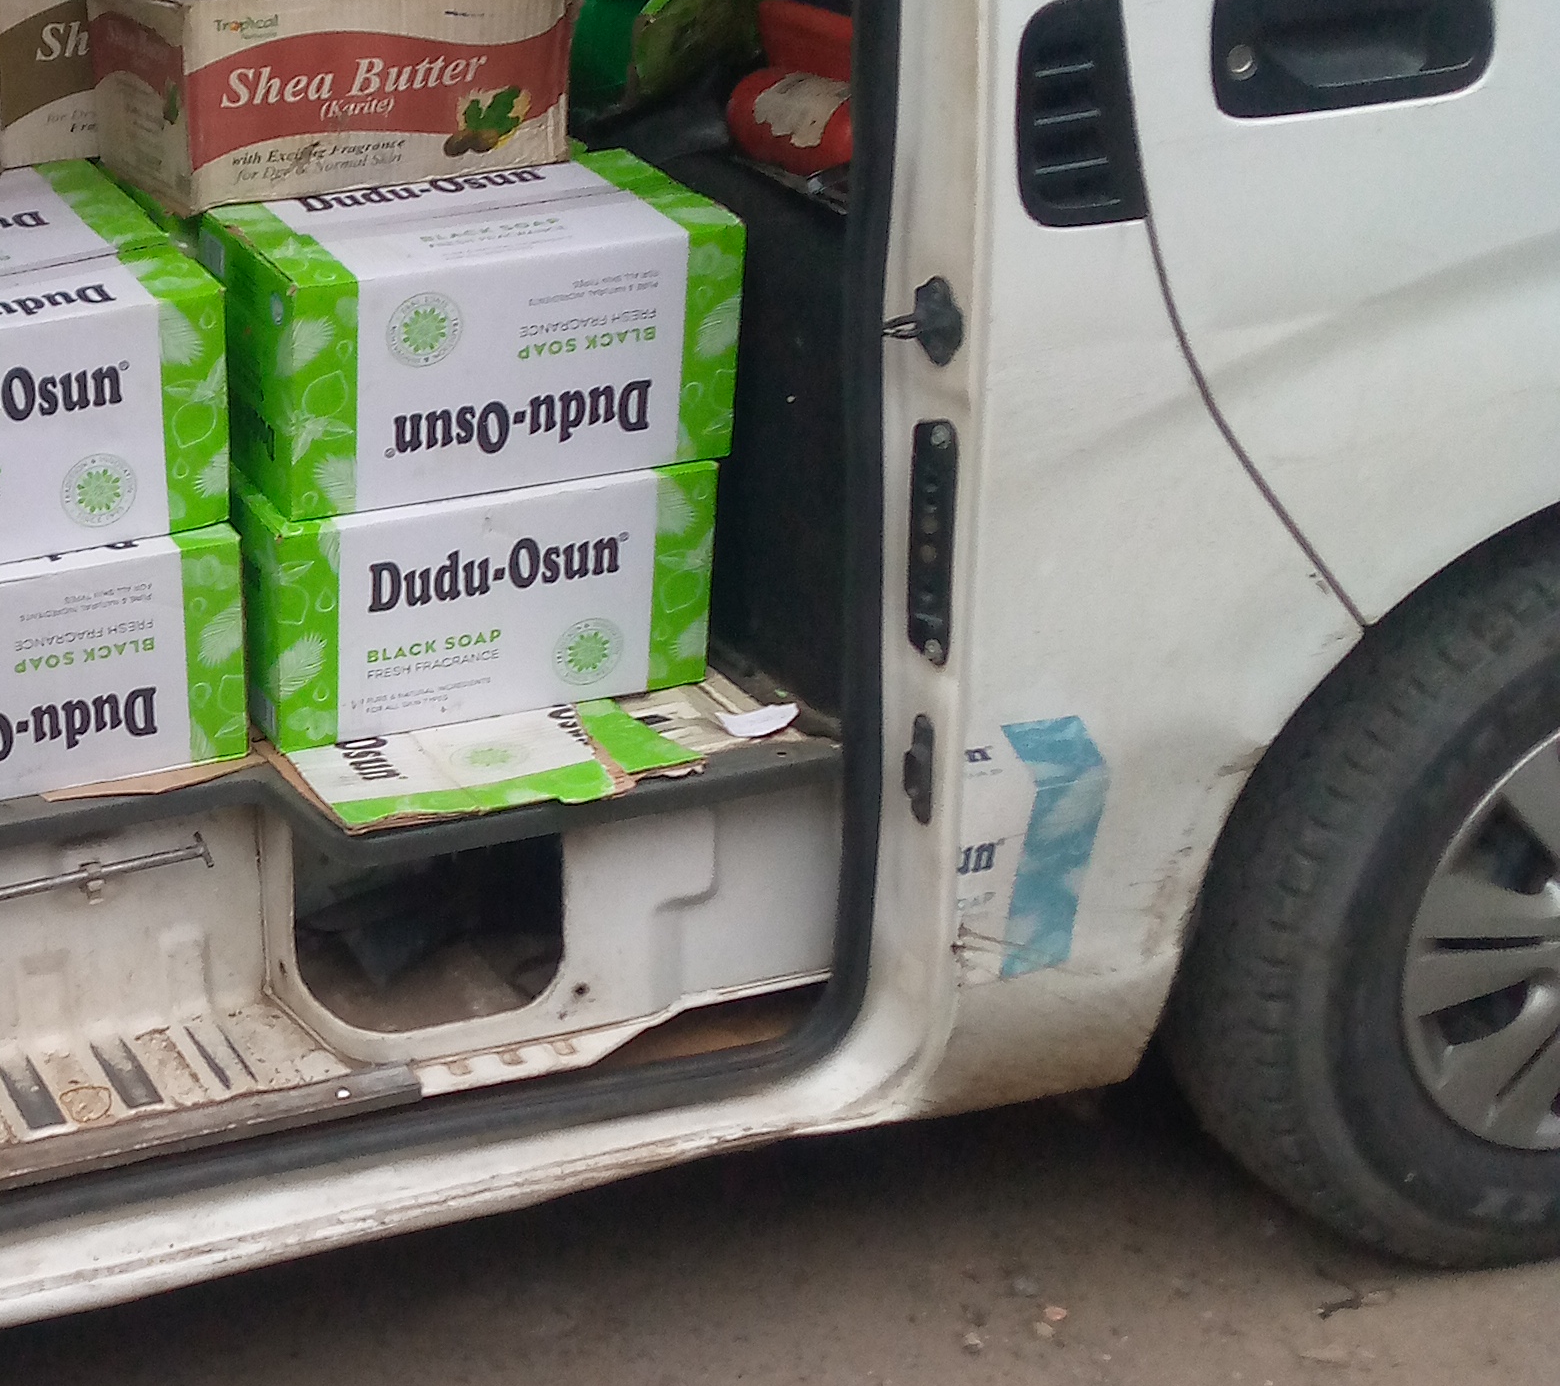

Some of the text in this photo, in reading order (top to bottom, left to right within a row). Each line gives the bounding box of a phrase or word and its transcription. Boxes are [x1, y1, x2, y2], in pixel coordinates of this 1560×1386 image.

[213, 14, 279, 38] Tropical
[221, 54, 489, 110] Shea Butter
[231, 151, 262, 167] with
[518, 306, 658, 338] FRESH FRAGRANCE
[515, 326, 658, 362] BLACK SOAP
[14, 618, 154, 651] FRESH FRAGRANCE
[365, 629, 503, 664] BLACK SOAP
[13, 637, 156, 674] BLACK SOAP
[366, 649, 500, 680] FRESH FRAGRANCE
